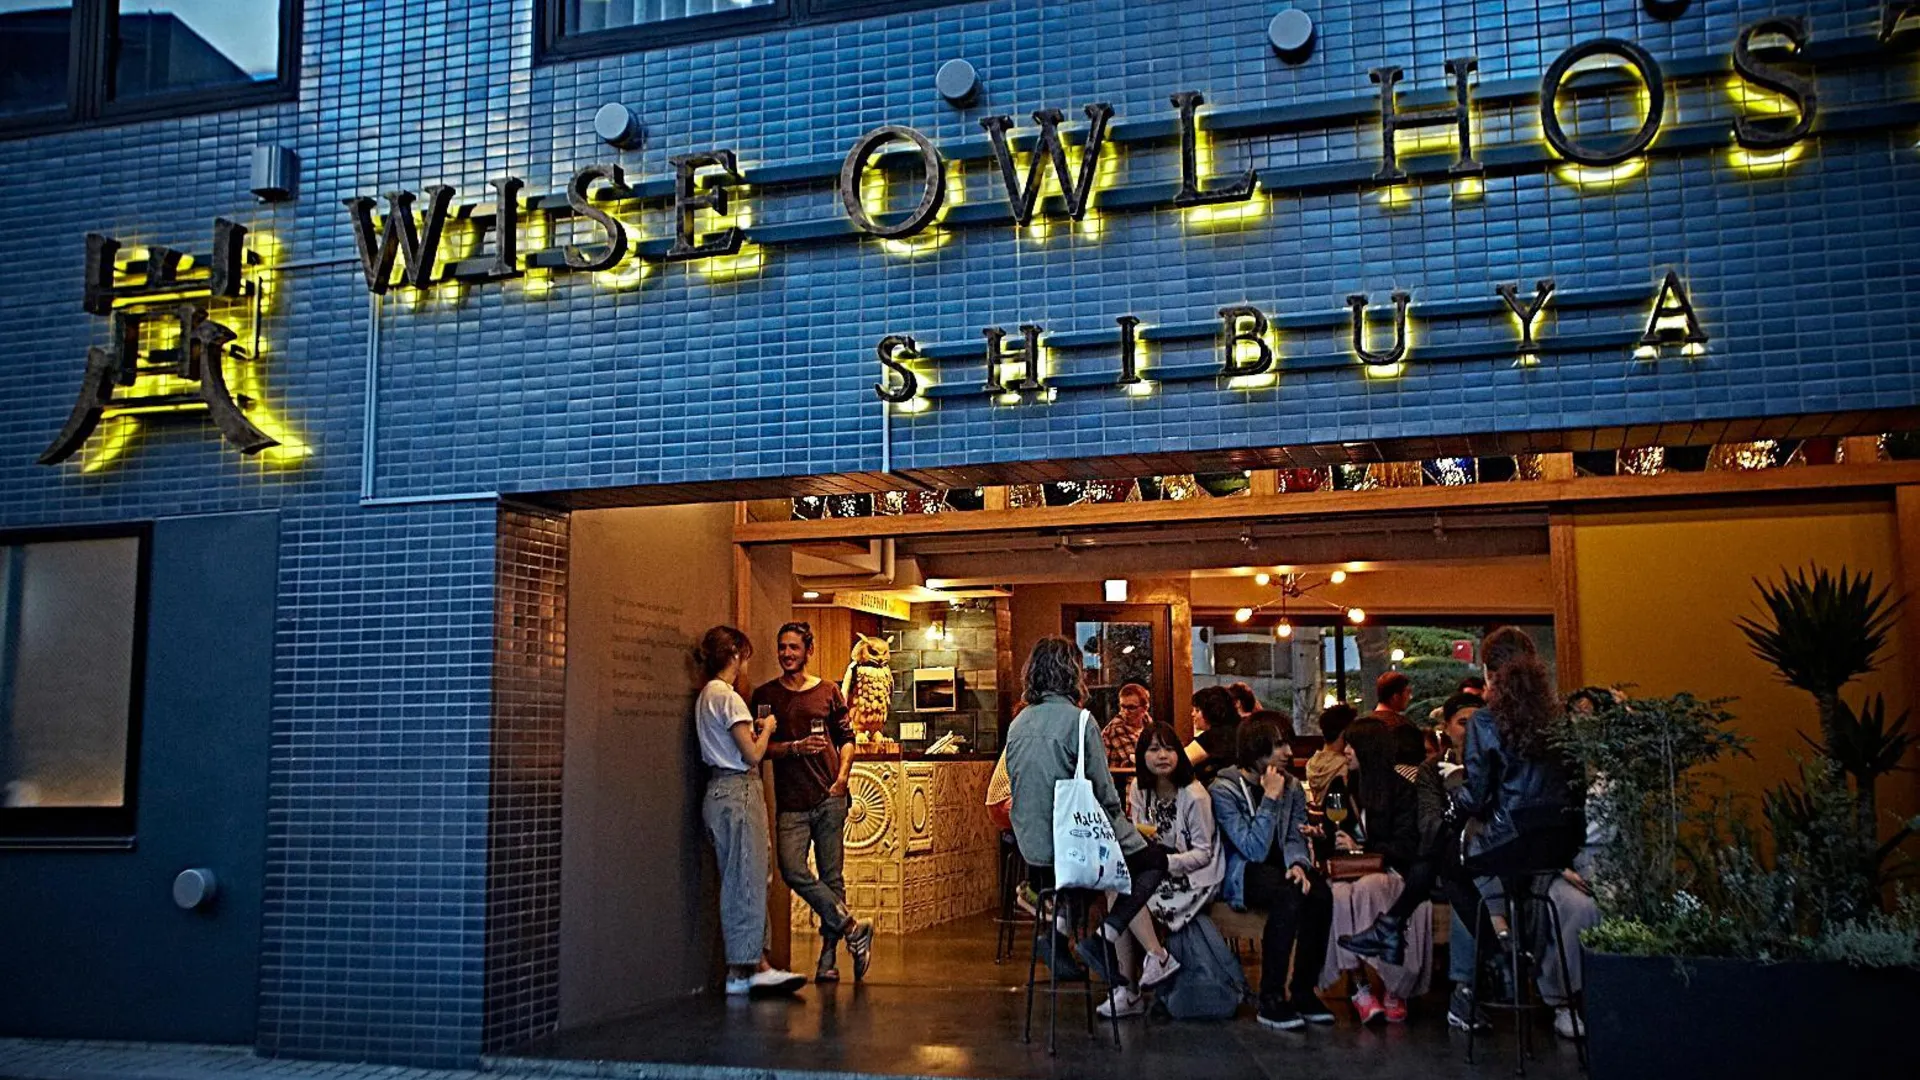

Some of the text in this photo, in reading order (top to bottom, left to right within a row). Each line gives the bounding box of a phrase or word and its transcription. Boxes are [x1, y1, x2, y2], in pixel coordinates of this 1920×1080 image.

[343, 3, 1920, 295] WISE OWL HOS
[875, 270, 1709, 402] SHIBUYA
